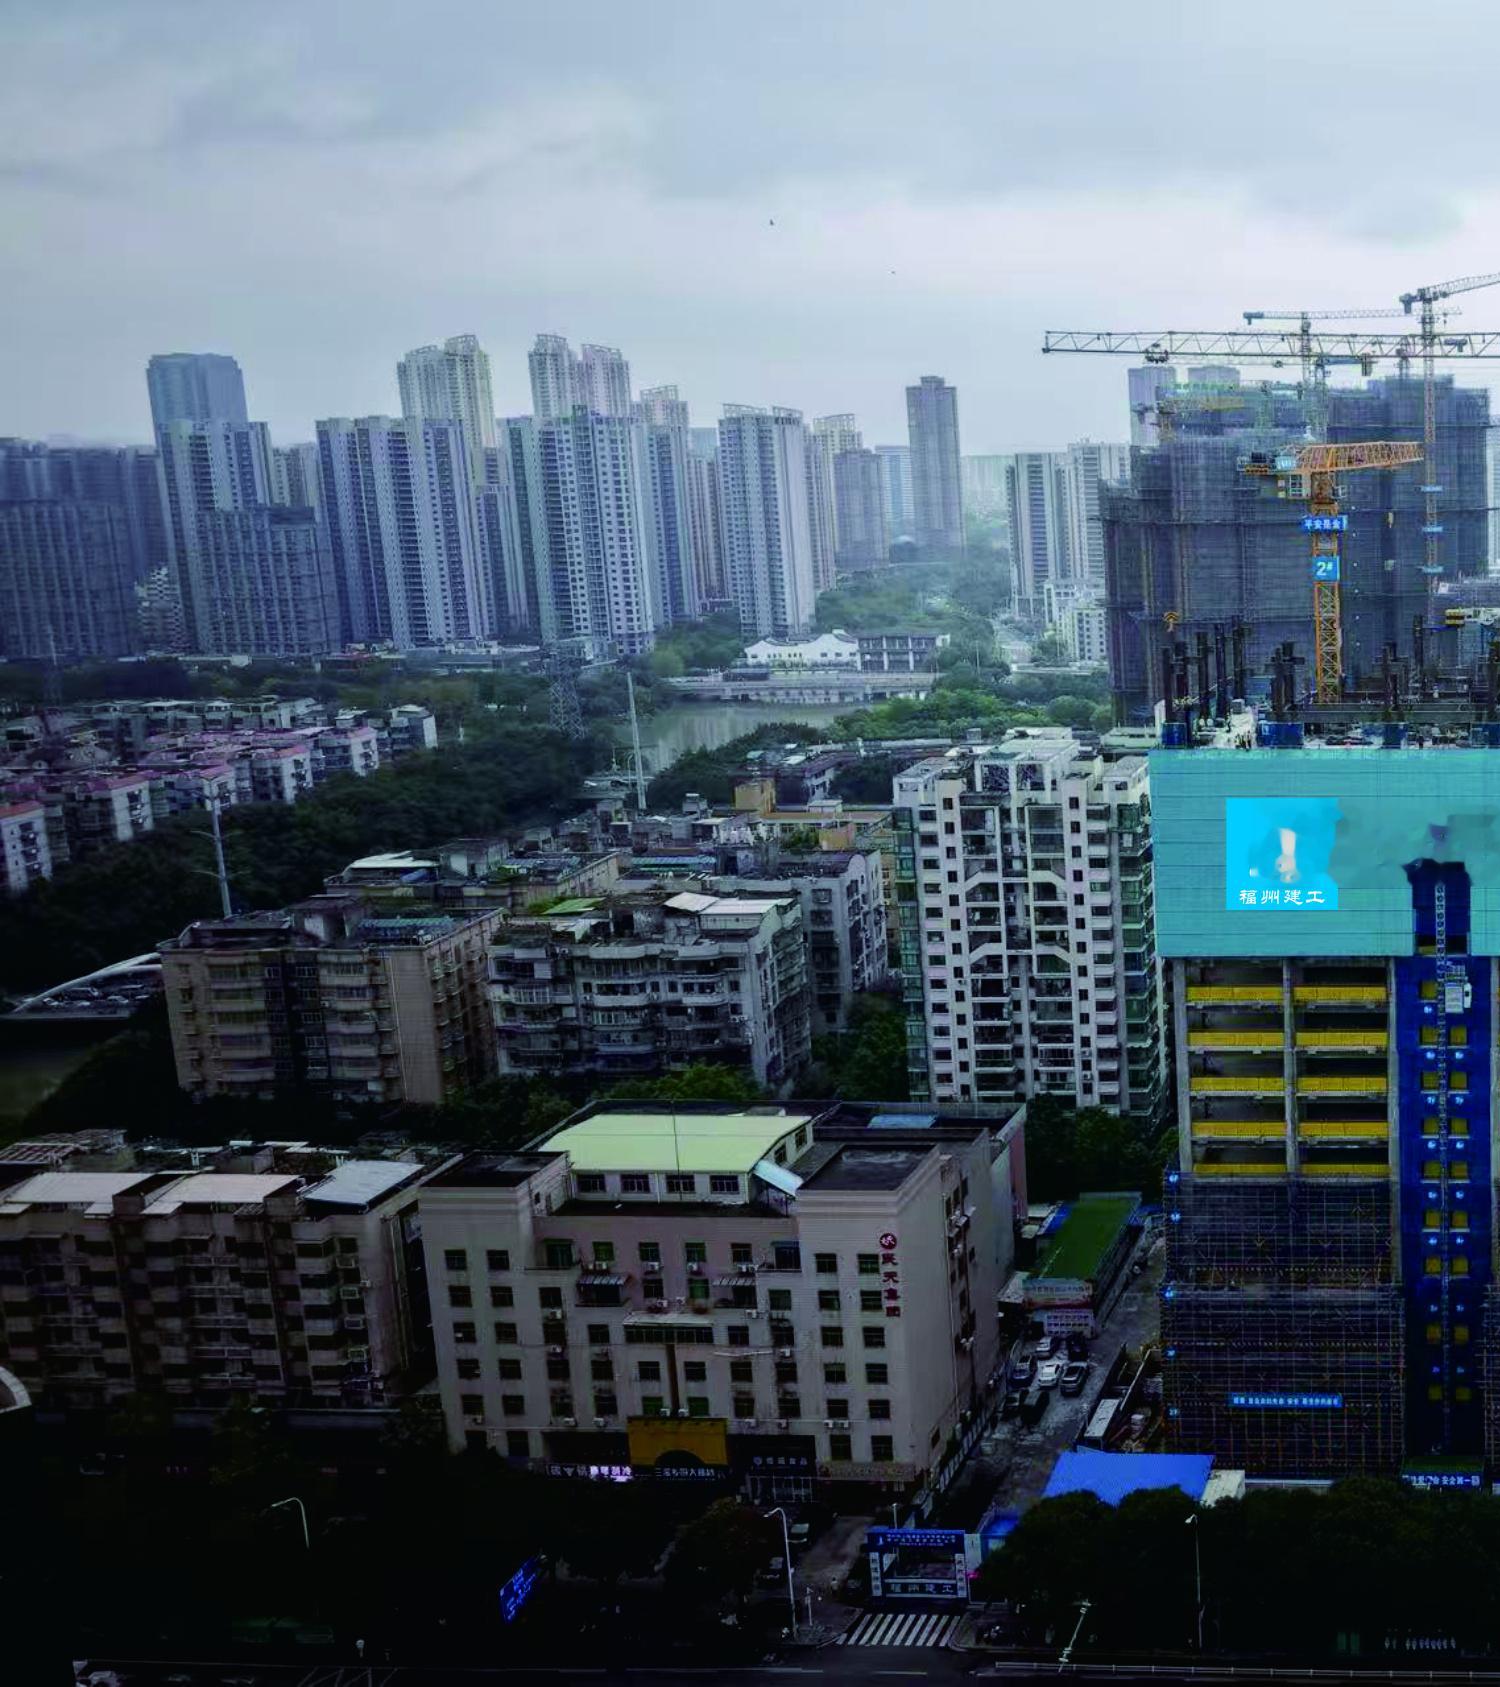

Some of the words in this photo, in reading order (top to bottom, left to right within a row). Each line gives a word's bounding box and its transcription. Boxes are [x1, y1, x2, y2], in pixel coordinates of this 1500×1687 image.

[1316, 560, 1334, 576] 2#
[1239, 889, 1326, 906] 福州建工
